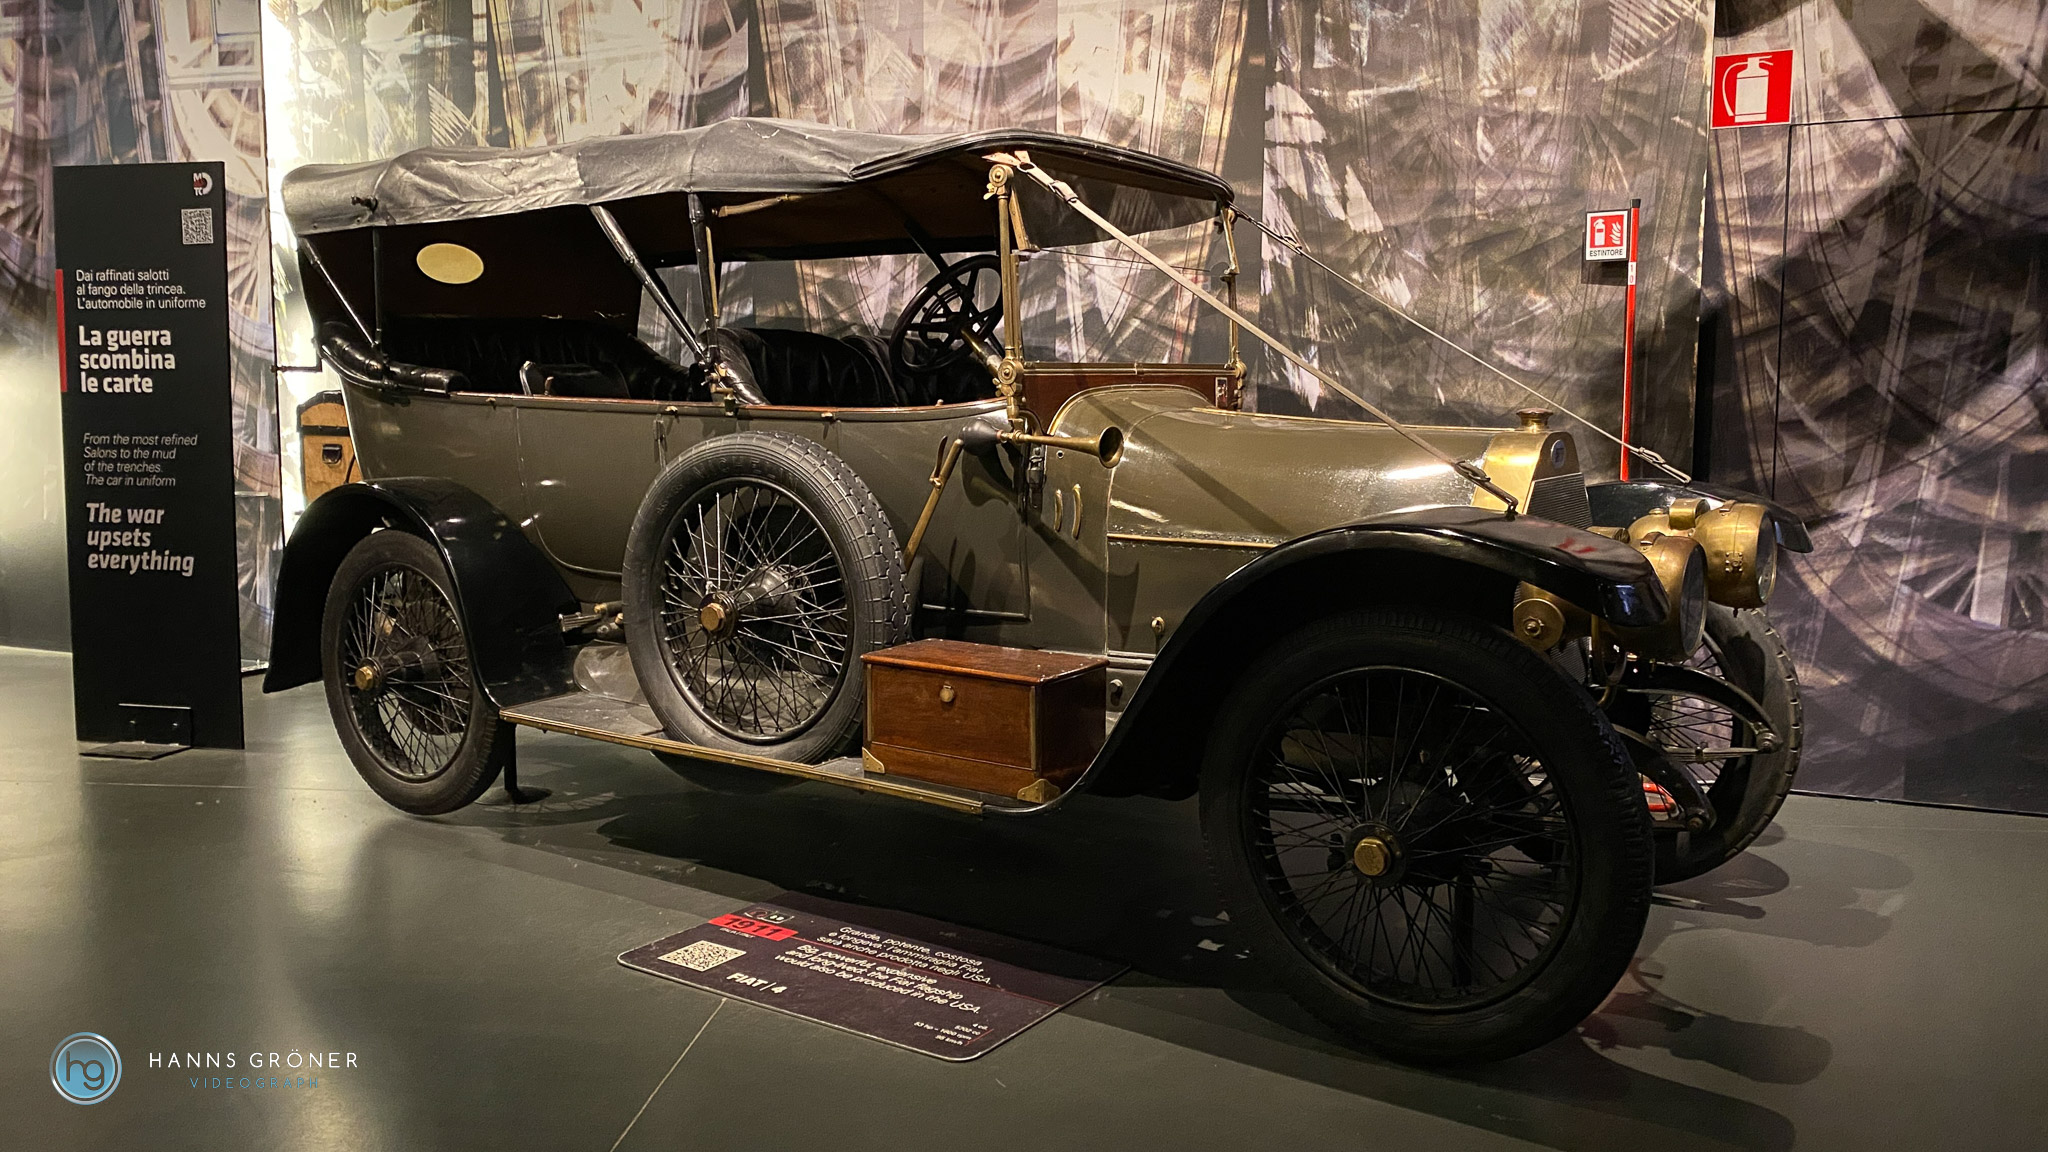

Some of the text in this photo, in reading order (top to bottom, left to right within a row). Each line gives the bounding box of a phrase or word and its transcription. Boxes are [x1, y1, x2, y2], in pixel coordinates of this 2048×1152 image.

[1589, 248, 1623, 257] ESTINTORE
[75, 268, 169, 281] Dai raffinati salotti
[76, 283, 186, 298] al fango della trincea.
[77, 297, 206, 309] L'automobile in uniforme
[78, 325, 171, 351] La guerra
[79, 348, 176, 370] scombina
[80, 371, 153, 393] le carte
[83, 432, 198, 446] From the most refined
[83, 447, 176, 460] Salons to the mud
[84, 461, 163, 473] of the trenches.
[86, 474, 176, 487] The car in uniform
[86, 502, 165, 525] The war
[87, 529, 151, 552] upsets
[88, 550, 194, 577] everything
[723, 917, 784, 937] 1911
[842, 943, 878, 955] anche
[876, 952, 929, 968] prodotta
[929, 964, 962, 976] negli
[962, 972, 991, 985] USA.
[935, 951, 983, 966] costosa
[785, 950, 813, 959] and
[866, 970, 889, 981] the
[888, 976, 915, 987] Fiat
[913, 983, 964, 1000] flagship
[876, 966, 938, 985] expensive
[958, 963, 985, 975] Fiat
[726, 972, 788, 994] FIAT 4
[774, 955, 981, 1014] would also be produced in the USA.
